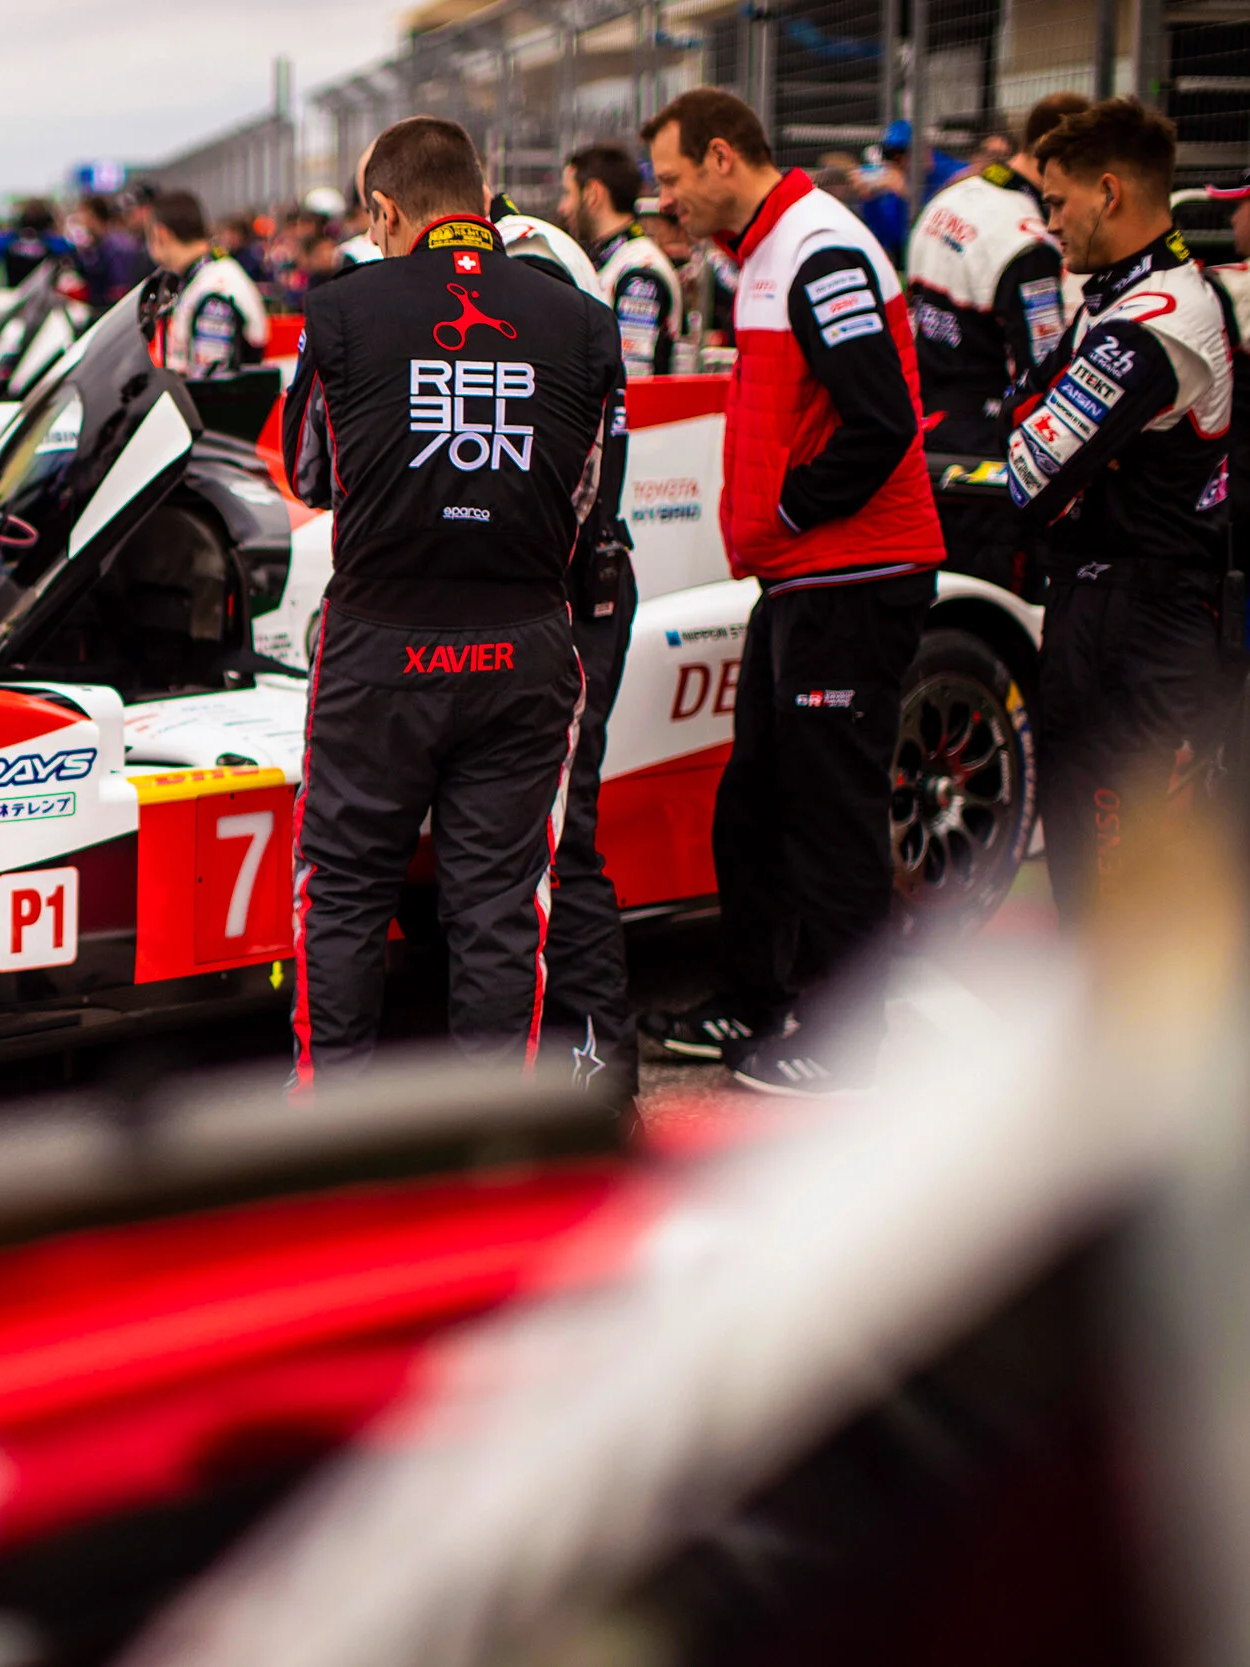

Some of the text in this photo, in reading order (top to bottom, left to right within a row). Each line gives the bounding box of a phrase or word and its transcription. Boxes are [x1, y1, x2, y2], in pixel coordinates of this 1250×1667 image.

[1074, 364, 1116, 399] JTEKT
[1060, 382, 1103, 417] AISIN
[442, 506, 491, 521] sparco
[403, 642, 515, 674] XAVIER
[215, 811, 275, 939] 7
[10, 884, 65, 955] P1
